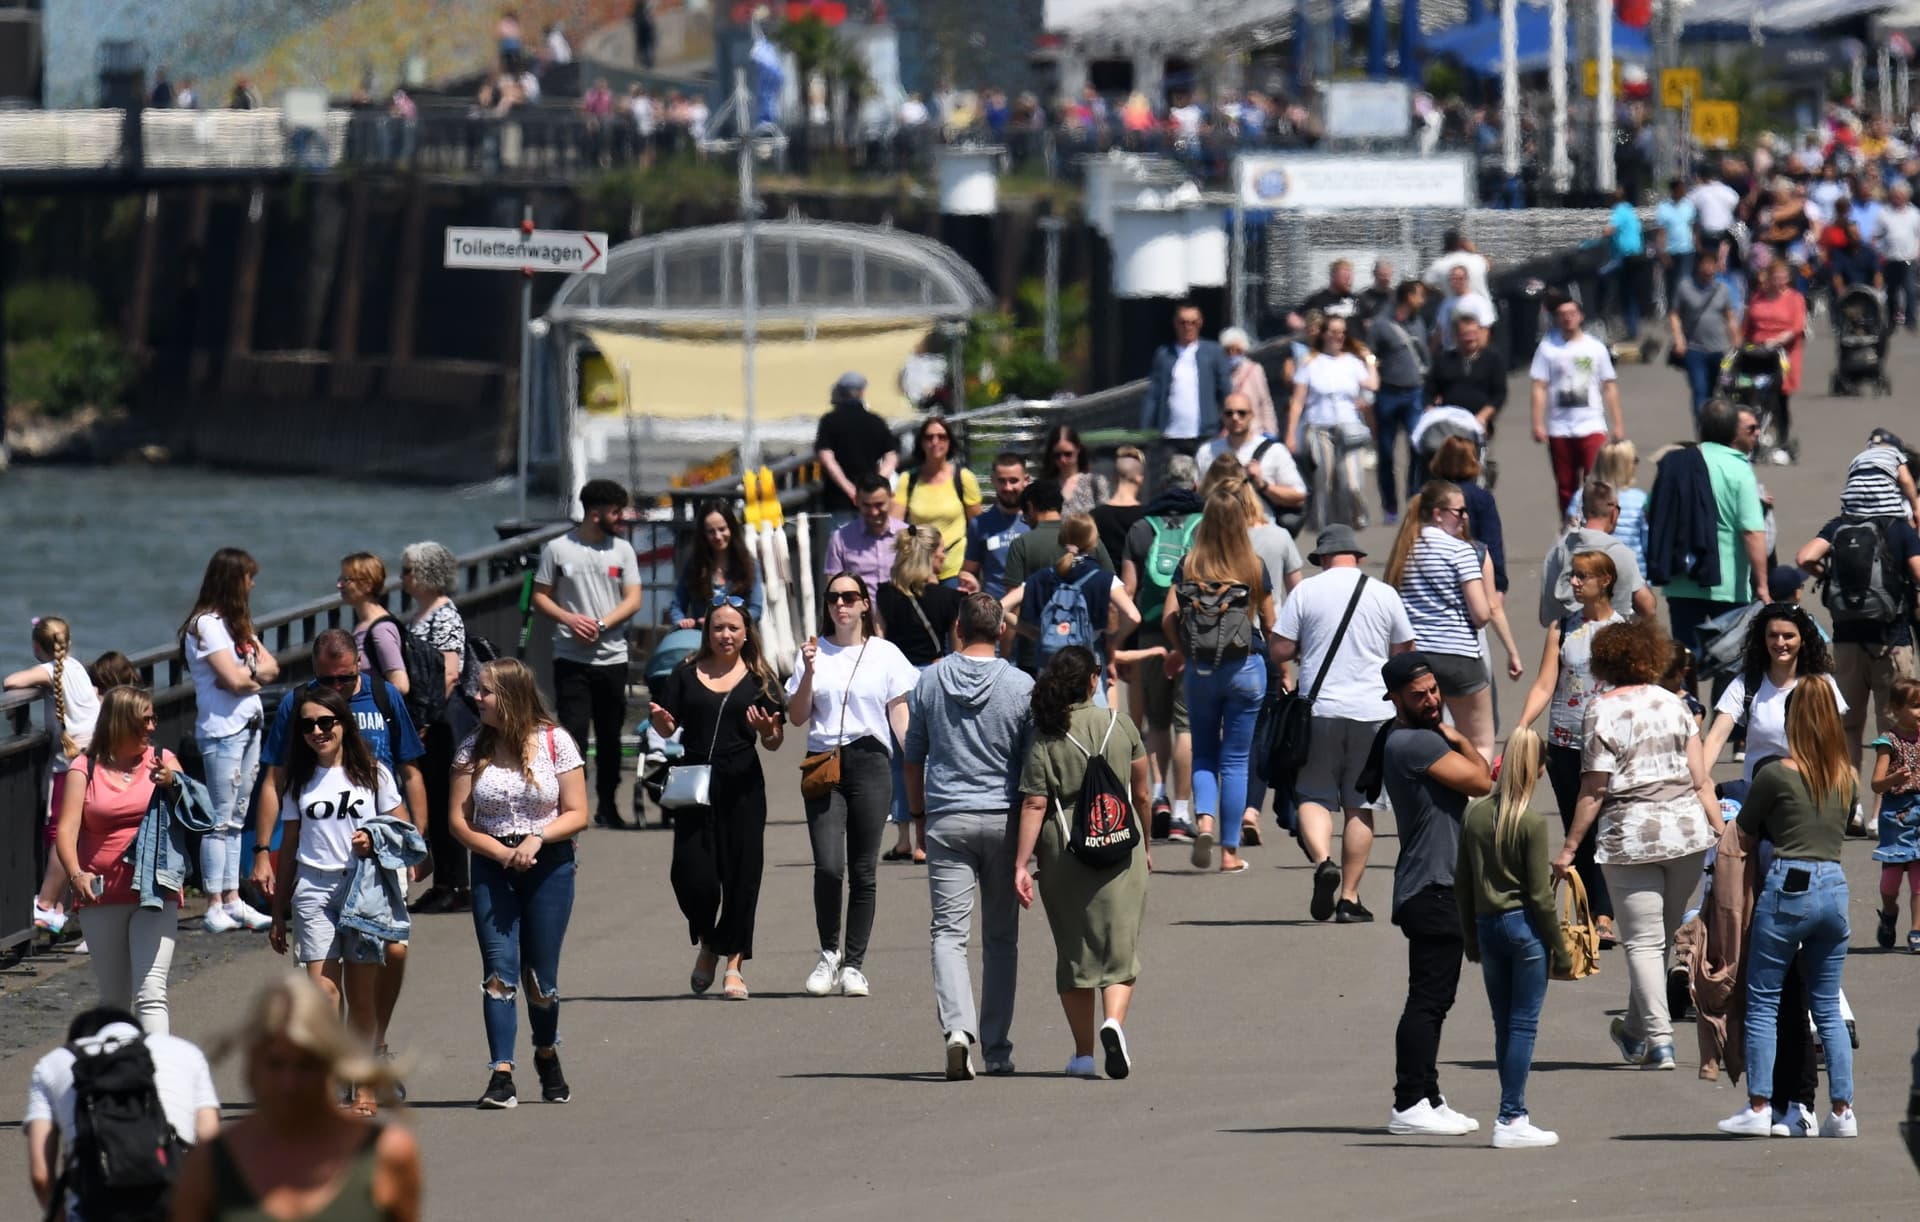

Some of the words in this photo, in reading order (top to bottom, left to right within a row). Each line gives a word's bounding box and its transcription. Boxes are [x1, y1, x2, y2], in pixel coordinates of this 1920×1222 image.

[453, 237, 583, 264] Toilettenwagen
[305, 790, 365, 820] ok
[1110, 828, 1131, 845] RING
